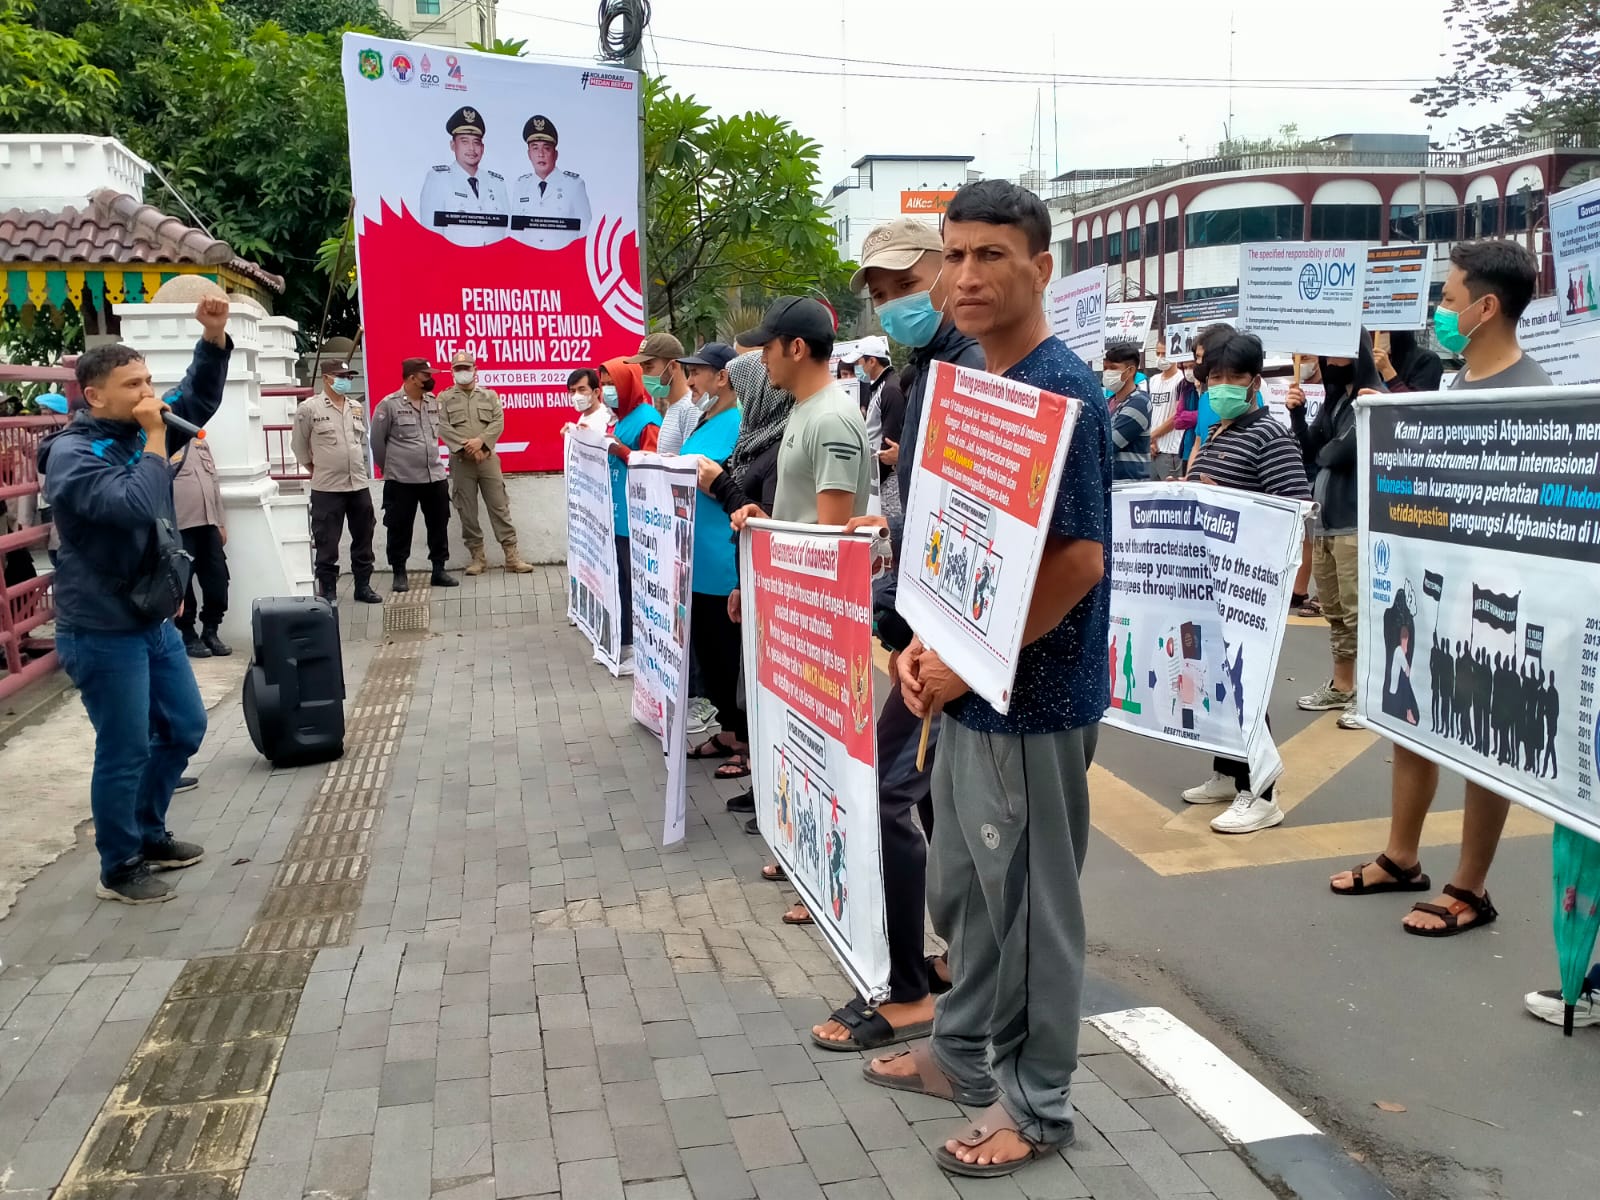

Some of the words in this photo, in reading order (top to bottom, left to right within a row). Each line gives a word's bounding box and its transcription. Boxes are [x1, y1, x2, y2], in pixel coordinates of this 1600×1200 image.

[420, 74, 440, 83] G20
[1248, 250, 1258, 259] The
[1259, 249, 1284, 260] specified
[1324, 248, 1331, 258] of
[1332, 248, 1345, 258] IOM
[1324, 262, 1356, 286] IOM
[462, 288, 562, 312] PERINGATAN
[1086, 293, 1102, 315] IOM
[420, 313, 460, 337] HARI
[465, 314, 532, 337] SUMPAH
[538, 314, 602, 337] PEMUDA
[1532, 313, 1547, 326] main
[1548, 310, 1560, 323] dut
[436, 339, 488, 363] KE-94
[492, 340, 546, 363] TAHUN
[550, 340, 592, 362] 2022
[484, 373, 536, 384] OKTOBER
[541, 372, 566, 383] 2022
[956, 370, 974, 394] Tolong
[974, 377, 1004, 400] pemerintah
[501, 392, 544, 410] BANGUN
[546, 392, 574, 408] BANG
[1395, 421, 1422, 440] Kami
[1420, 424, 1444, 444] para
[1445, 420, 1498, 445] pengungsi
[1500, 419, 1573, 446] Afghanistan,
[1425, 450, 1478, 470] instrumen
[1480, 450, 1518, 472] hukum
[1519, 451, 1598, 474] internasional
[1377, 474, 1412, 495] Indonesia
[1414, 477, 1428, 496] dan
[1428, 477, 1484, 504] kurangnya
[1483, 482, 1539, 506] perhatian
[1540, 482, 1566, 507] IOM
[1184, 506, 1192, 525] of
[1389, 502, 1448, 528] ketidakpastian
[1450, 512, 1505, 538] pengungsi
[1504, 513, 1577, 542] Afghanistan
[1578, 520, 1592, 544] di
[1113, 541, 1124, 553] are
[1125, 539, 1131, 553] of
[1222, 554, 1232, 572] to
[1234, 558, 1250, 577] the
[1252, 565, 1279, 586] status
[1134, 559, 1154, 578] keep
[1156, 562, 1175, 578] your
[1228, 582, 1267, 606] resettle
[1372, 578, 1392, 592] UNHCR
[824, 594, 843, 620] refugees
[1177, 583, 1215, 600] UNHCR
[1226, 606, 1268, 632] process.
[1475, 599, 1482, 611] WE
[1490, 604, 1506, 622] HUMANS
[1532, 629, 1542, 640] YEARS
[1584, 633, 1600, 647] 2013
[1530, 640, 1542, 650] ENOUGH
[1582, 648, 1598, 662] 2014
[1581, 664, 1596, 678] 2015
[818, 669, 839, 699] Indonesia
[1580, 680, 1594, 694] 2016
[1580, 696, 1592, 709] 2017
[1579, 710, 1591, 725] 2018
[1164, 726, 1200, 742] RESETTLEMENT
[1578, 726, 1591, 740] 2019
[1578, 741, 1590, 755] 2020
[1579, 756, 1590, 771] 2021
[1579, 772, 1591, 786] 2022
